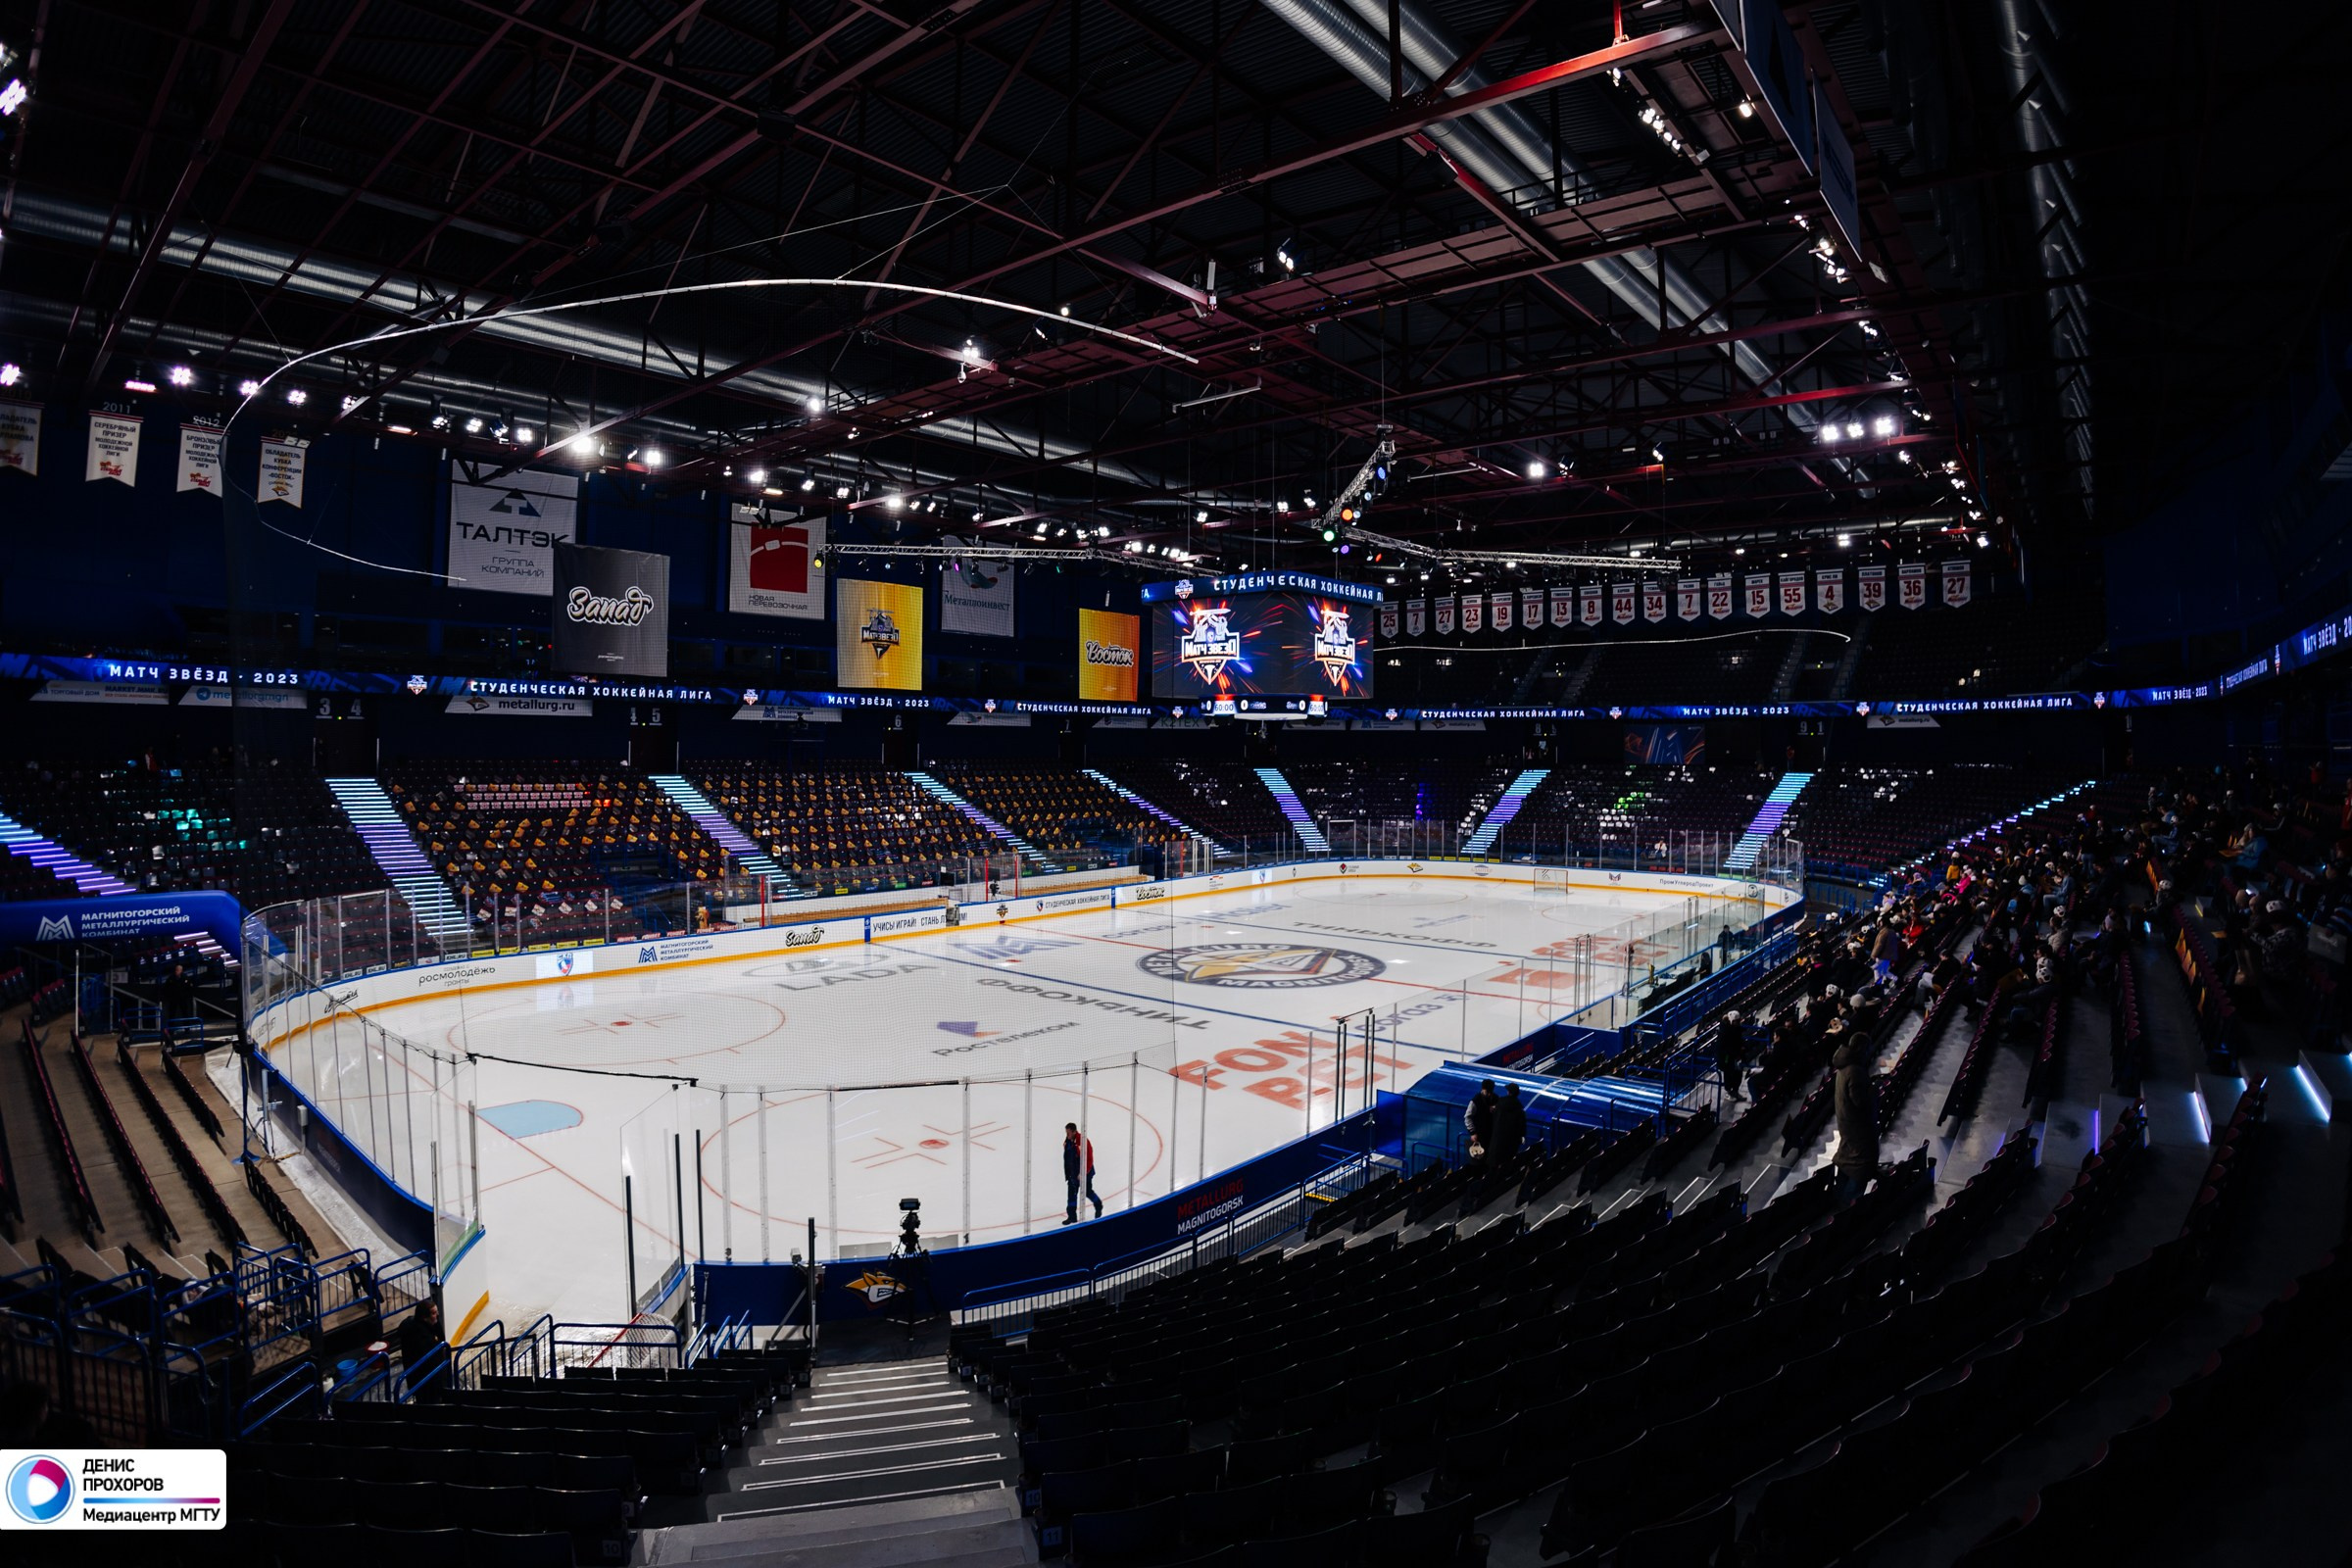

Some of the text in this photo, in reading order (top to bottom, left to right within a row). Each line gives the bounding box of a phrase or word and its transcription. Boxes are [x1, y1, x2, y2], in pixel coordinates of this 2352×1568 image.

[102, 401, 131, 415] 2011
[0, 414, 37, 425] ЛАДАТЕЛЬ
[193, 415, 220, 428] 2012
[1, 422, 25, 432] КУБКА
[94, 421, 137, 433] СЕРЕБРЯНЫЙ
[0, 432, 34, 442] РЛАМОВА
[102, 430, 127, 439] ПРИЗЕР
[192, 442, 216, 451] ПРИЗЕР
[265, 448, 302, 460] ОБЛАДАТЕЛЬ
[273, 457, 292, 466] КУБКА
[457, 521, 570, 549] ТАЛТЭК
[492, 556, 535, 567] ГРУППА
[481, 564, 545, 578] КОМПАНИЙ
[1213, 574, 1317, 592] СТУДЕНЧЕСКАЯ
[1320, 579, 1374, 601] ХОККЕЙНАЯ
[1825, 585, 1835, 601] 4
[1863, 582, 1882, 599] 39
[1903, 579, 1922, 596] 36
[1946, 577, 1966, 595] 27
[1685, 594, 1693, 609] 7
[1711, 592, 1728, 608] 22
[1751, 589, 1765, 606] 15
[1784, 587, 1801, 604] 55
[566, 586, 655, 627] Запад
[748, 600, 808, 611] ПЕРЕВОЗОЧНАЯ
[944, 594, 1010, 612] Металлоинвест
[1555, 602, 1568, 616] 13
[1588, 600, 1595, 614] 8
[1615, 598, 1633, 612] 44
[1646, 596, 1664, 611] 34
[1439, 610, 1451, 624] 27
[1465, 609, 1479, 622] 23
[1497, 607, 1508, 620] 19
[1527, 604, 1539, 618] 17
[1383, 614, 1396, 627] 25
[1412, 612, 1420, 626] 7
[1085, 640, 1135, 667] Восток
[109, 663, 300, 685] МАТЧ ЗВЁЗД 2023
[469, 680, 713, 701] СТУДЕНЧЕСКАЯ ХОККЕЙНАЯ ЛИГА
[2152, 685, 2208, 702] МАТЧ ЗВЁЗД 2023
[319, 697, 362, 716] 3 4
[498, 698, 575, 713] metallurg.ru
[827, 694, 930, 708] МАТЧ ЗВЁЗД 2023
[1214, 703, 1234, 712] 60:00
[1896, 697, 2073, 713] СТУДЕНЧЕСКАЯ ХОККЕЙНАЯ ЛИГА
[652, 708, 662, 723] 5
[1016, 702, 1152, 716] СТУДЕНЧЕСКАЯ ХОККЕЙНАЯ ЛИГА
[1421, 708, 1587, 719] СТУДЕНЧЕСКАЯ ХОККЕЙНАЯ ЛИГА
[1683, 705, 1790, 716] МАТЧ ЗВЁЗД 2023
[894, 713, 903, 728] 6
[1799, 720, 1807, 733] 9
[1045, 898, 1077, 909] СТУДЕНЧЕСКАЯ
[80, 906, 182, 922] МАГНИТОГОРСКИЙ
[80, 913, 191, 931] МЕТАЛЛУРГИЧЕСКИЙ
[920, 916, 940, 927] СТАНЬ
[80, 927, 141, 939] КОМБИНАТ
[785, 924, 825, 947] Запад
[1293, 921, 1497, 949] ТИНЬКОФФ
[660, 939, 710, 950] МАГНИТОГОРСКИЙ
[660, 944, 713, 956] МЕТАЛЛУРГИЧЕСКИЙ
[660, 953, 690, 961] КОМБИНАТ
[1147, 944, 1291, 976] METALLURG
[344, 969, 363, 979] KHL.RU
[368, 964, 386, 974] KHL.RU
[1217, 955, 1376, 989] MAGNITOGORSK
[418, 966, 497, 988] росмолодёжь
[773, 963, 941, 992] LADA
[975, 977, 1211, 1031] ТИНЬКОФФ
[931, 1019, 1081, 1057] Ростелеком
[1167, 1030, 1341, 1092] FON
[1242, 1044, 1417, 1110] BET
[1177, 1176, 1245, 1223] METALLURG
[1177, 1194, 1244, 1236] MAGNITOGORSK
[1029, 1492, 1041, 1503] 10
[1047, 1530, 1059, 1544] 11
[604, 1543, 620, 1555] 10
